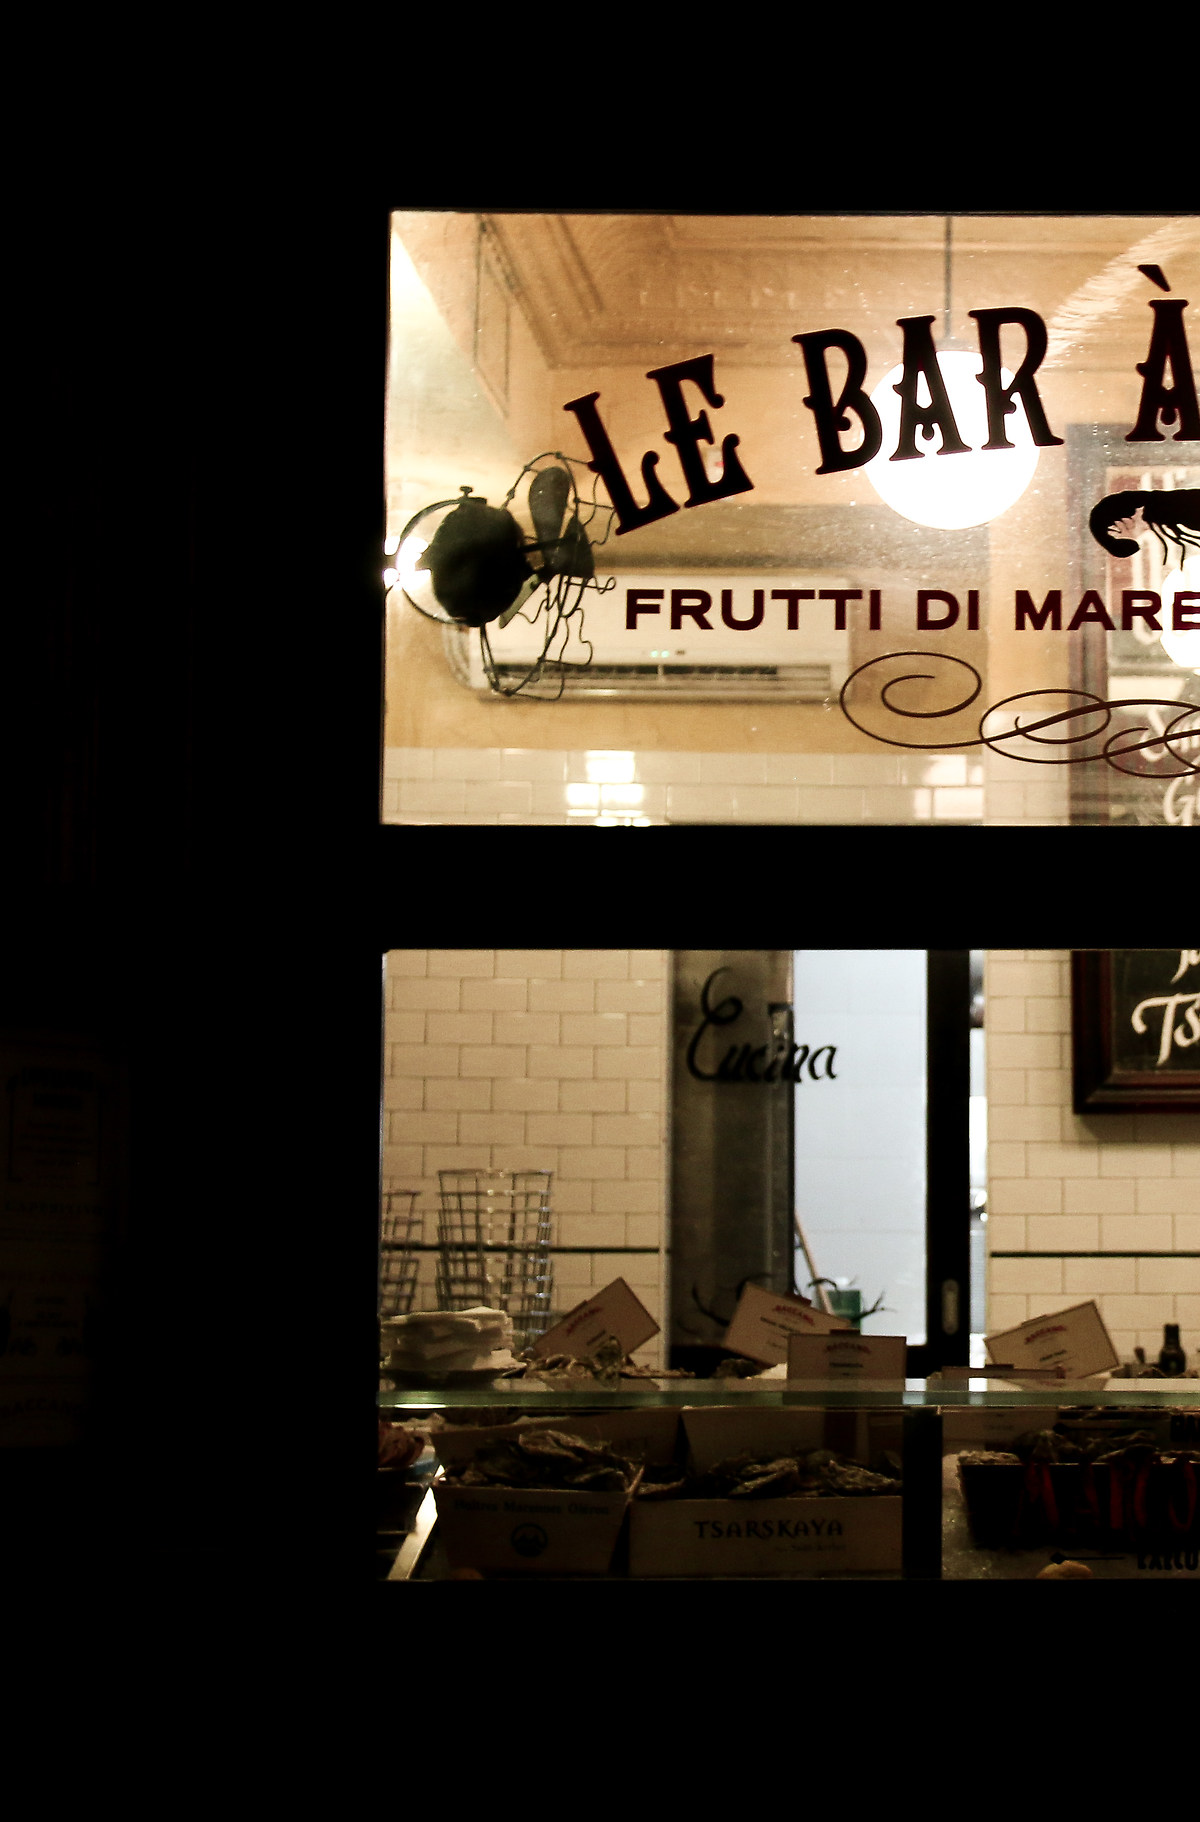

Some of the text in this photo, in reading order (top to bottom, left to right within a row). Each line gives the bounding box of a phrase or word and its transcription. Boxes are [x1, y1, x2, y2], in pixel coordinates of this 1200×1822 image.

[564, 354, 754, 536] LE
[792, 307, 1064, 475] BAR
[625, 589, 881, 631] FRUTTI
[916, 589, 980, 631] DI
[693, 1519, 844, 1540] TSARSKAYA
